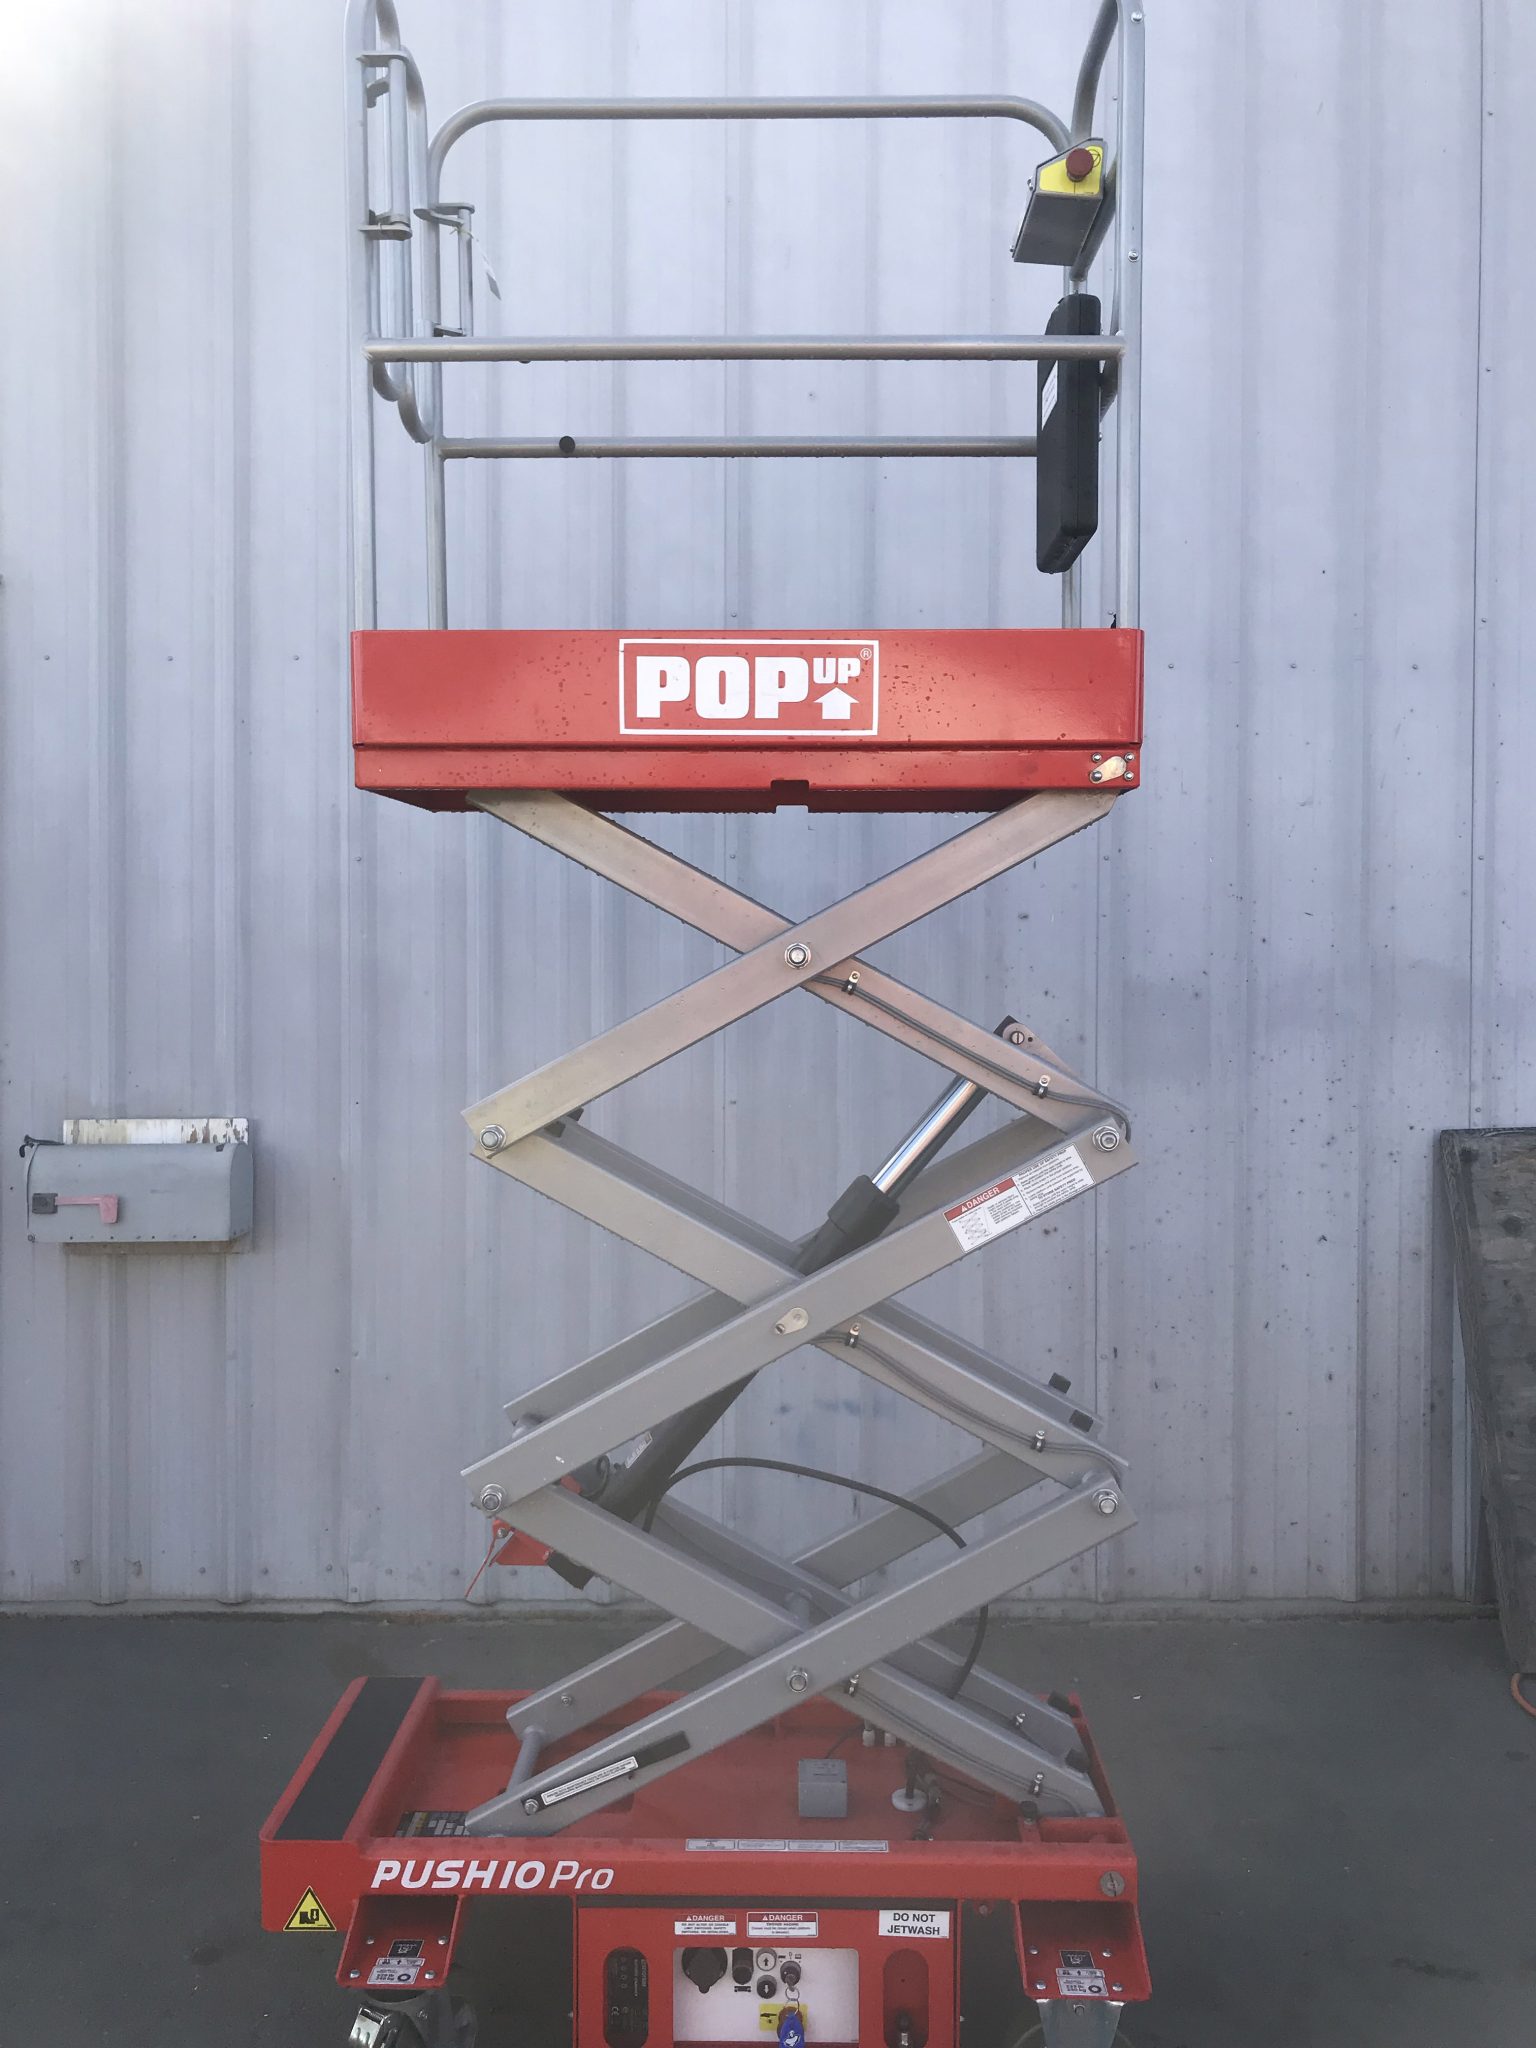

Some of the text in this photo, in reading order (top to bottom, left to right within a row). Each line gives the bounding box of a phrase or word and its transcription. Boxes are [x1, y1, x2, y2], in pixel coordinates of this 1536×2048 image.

[636, 656, 809, 719] POP
[813, 657, 861, 684] UP
[966, 1187, 1000, 1209] DANGER
[549, 1860, 614, 1890] Pro
[692, 1914, 725, 1922] DANGER
[893, 1912, 936, 1923] DO NOT
[887, 1925, 940, 1936] JETWASH
